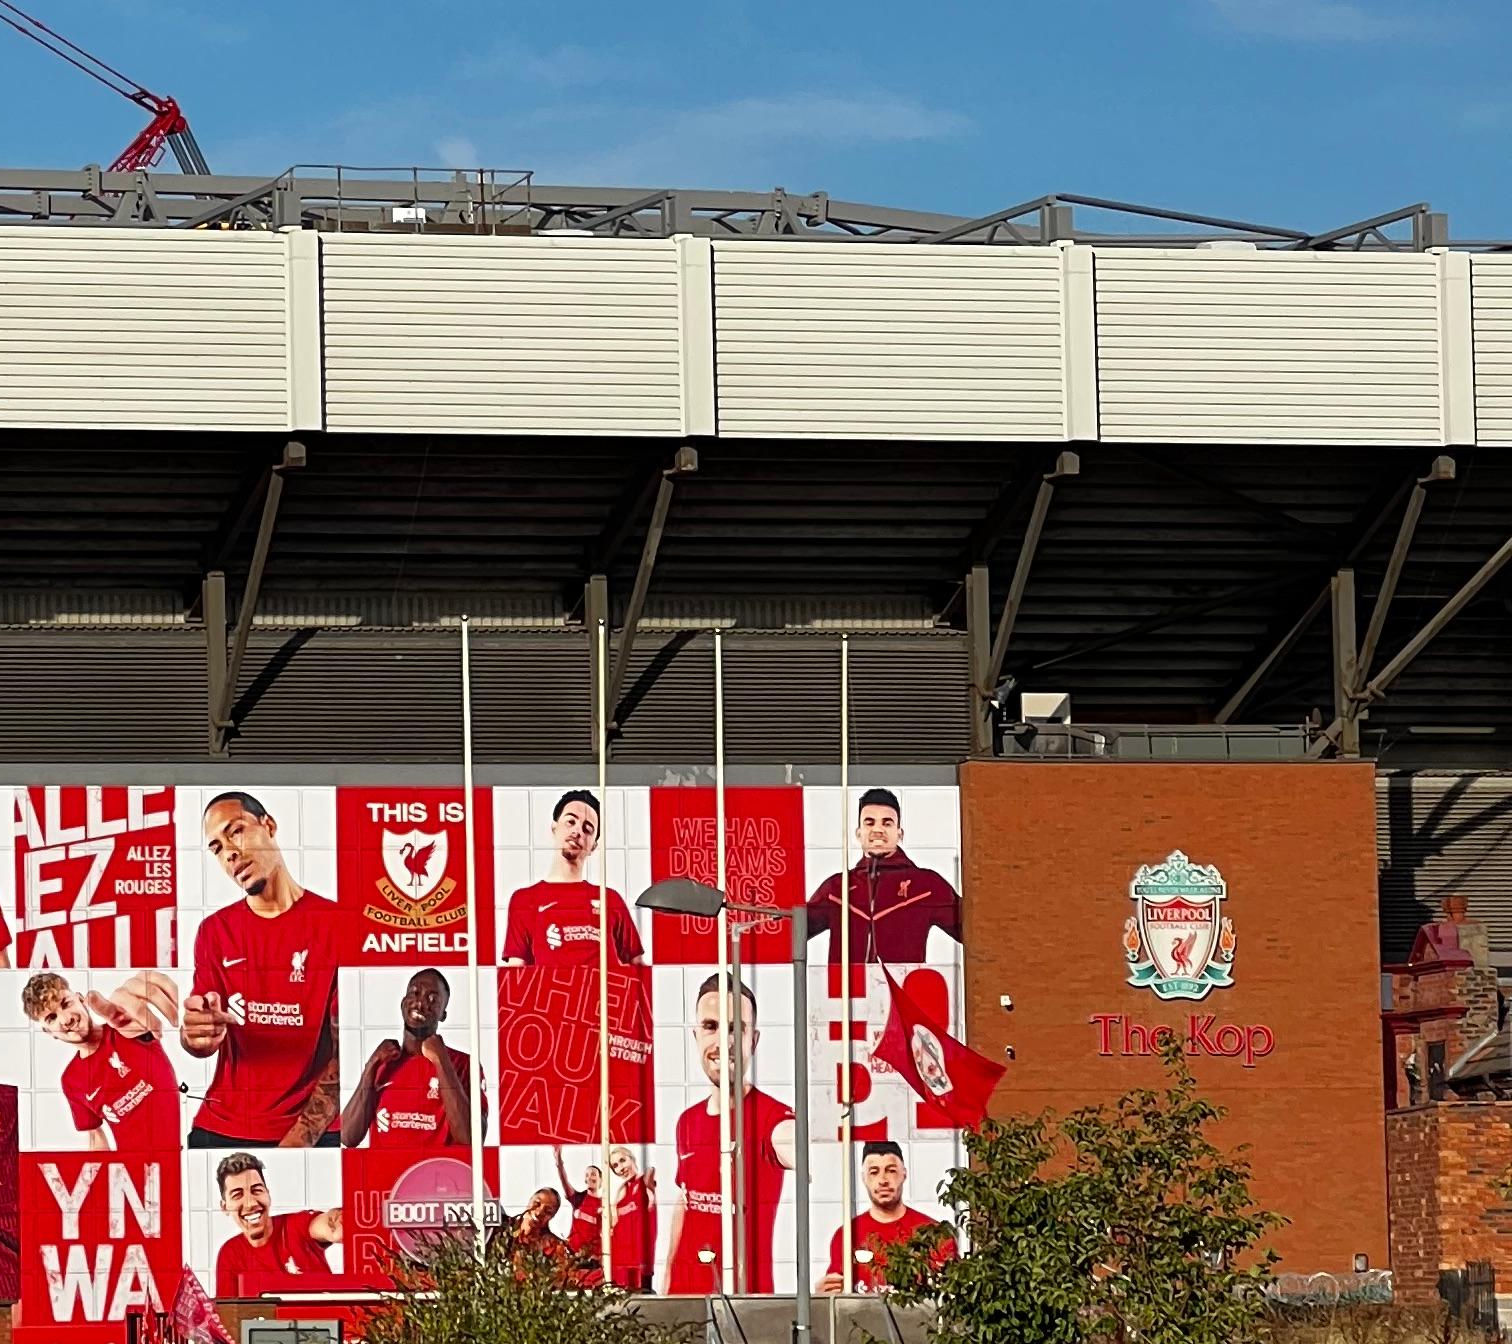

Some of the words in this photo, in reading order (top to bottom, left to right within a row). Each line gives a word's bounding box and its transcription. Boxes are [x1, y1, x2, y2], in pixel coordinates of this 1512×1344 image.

[366, 802, 428, 823] THIS
[439, 802, 465, 823] IS
[673, 817, 718, 848] WE
[126, 846, 172, 861] ALLEZ
[669, 846, 787, 877] DREAMS
[145, 863, 172, 878] LES
[115, 879, 173, 895] ROUGES
[367, 907, 431, 928] FOOTBALL
[435, 906, 467, 925] CLUB
[1147, 908, 1212, 921] LIVERPOOL
[362, 932, 469, 953] ANFIELD
[248, 1001, 300, 1015] standard
[248, 1013, 304, 1027] chartered
[608, 1033, 653, 1055] HROUGH
[1089, 1012, 1177, 1057] The
[1187, 1012, 1275, 1069] Kop
[609, 1047, 647, 1065] STORM
[37, 1162, 161, 1240] YN
[389, 1203, 440, 1223] BOOT
[39, 1244, 165, 1323] WA
